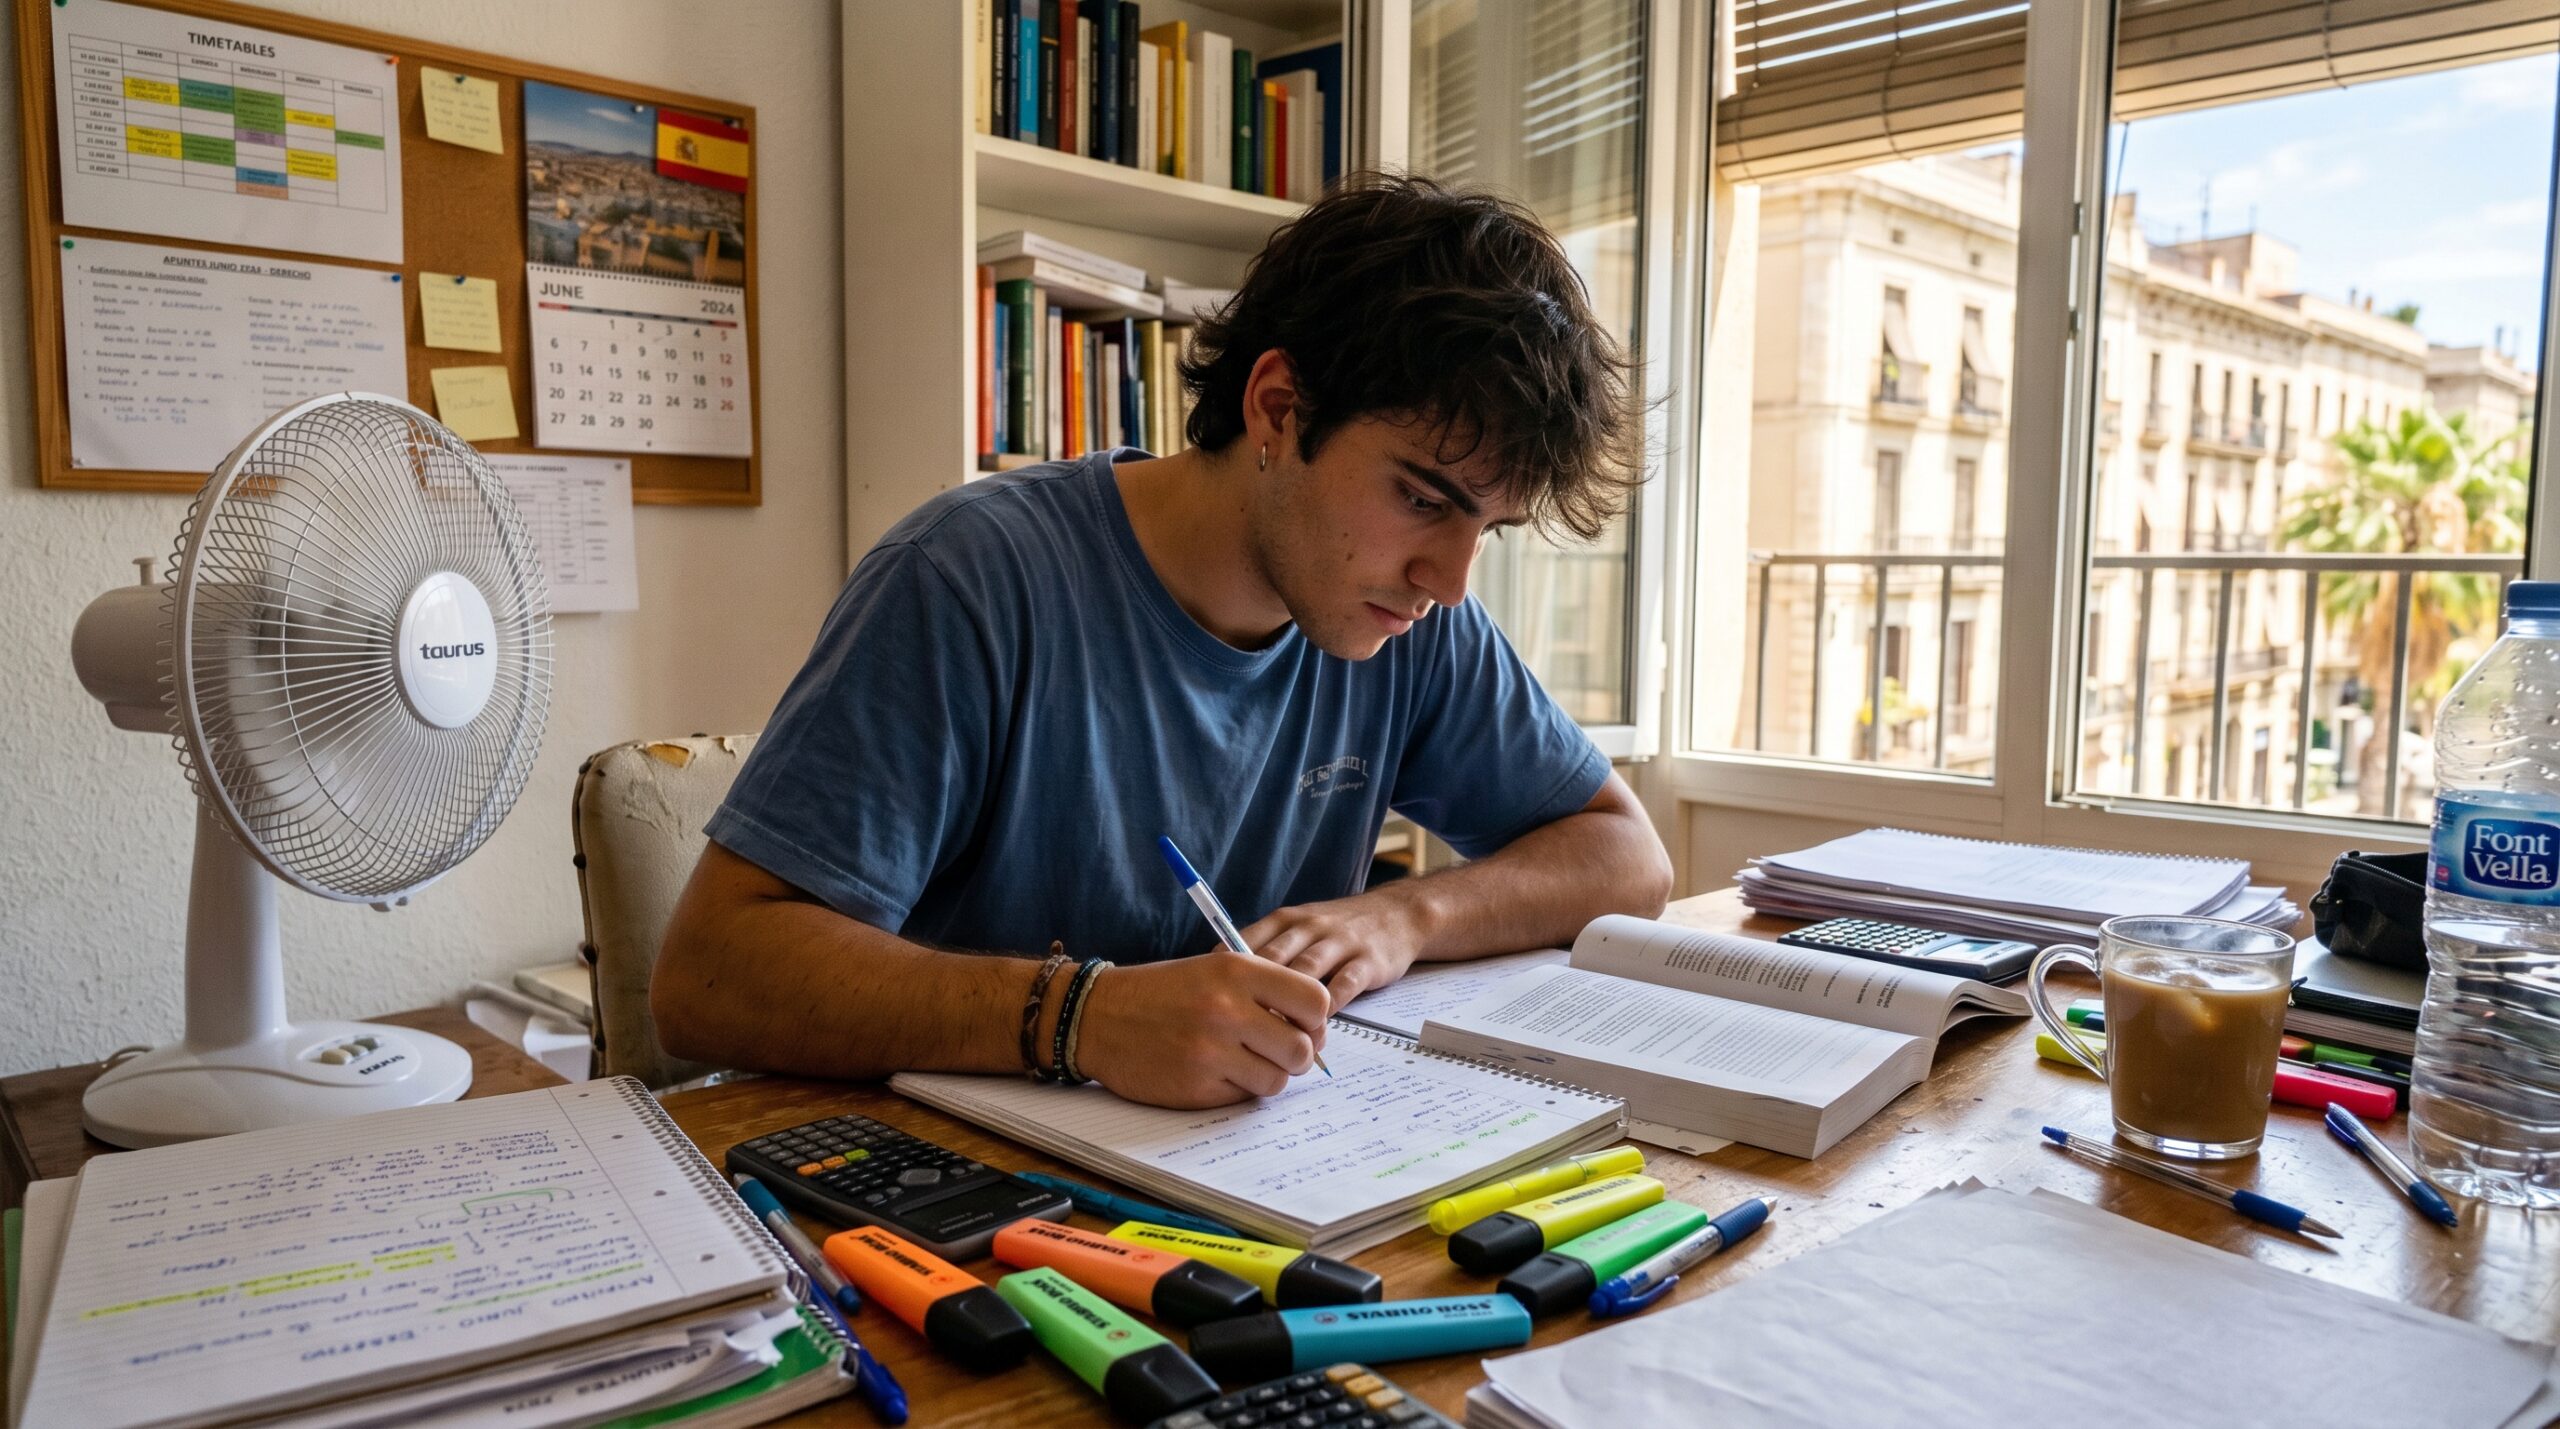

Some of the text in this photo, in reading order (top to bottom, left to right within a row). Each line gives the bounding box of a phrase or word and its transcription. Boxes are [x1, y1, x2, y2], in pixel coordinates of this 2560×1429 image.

[187, 31, 276, 59] TIMETABLES
[540, 282, 584, 300] JUNE
[700, 299, 735, 315] 2024
[610, 319, 616, 331] 1
[637, 322, 645, 333] 2
[665, 324, 673, 336] 3
[693, 328, 701, 338] 4
[551, 338, 732, 365] 6 7 8 9 10 11 12
[549, 362, 733, 388] 13 14 15 16 17 18 19
[549, 387, 734, 411] 20 21 22 23 24 25 26
[551, 412, 653, 430] 27 28 29 30
[419, 642, 485, 660] taurus
[2472, 824, 2552, 856] Font
[2470, 851, 2552, 884] Vella
[1345, 1306, 1432, 1320] STABILO
[1435, 1302, 1491, 1313] BOSS
